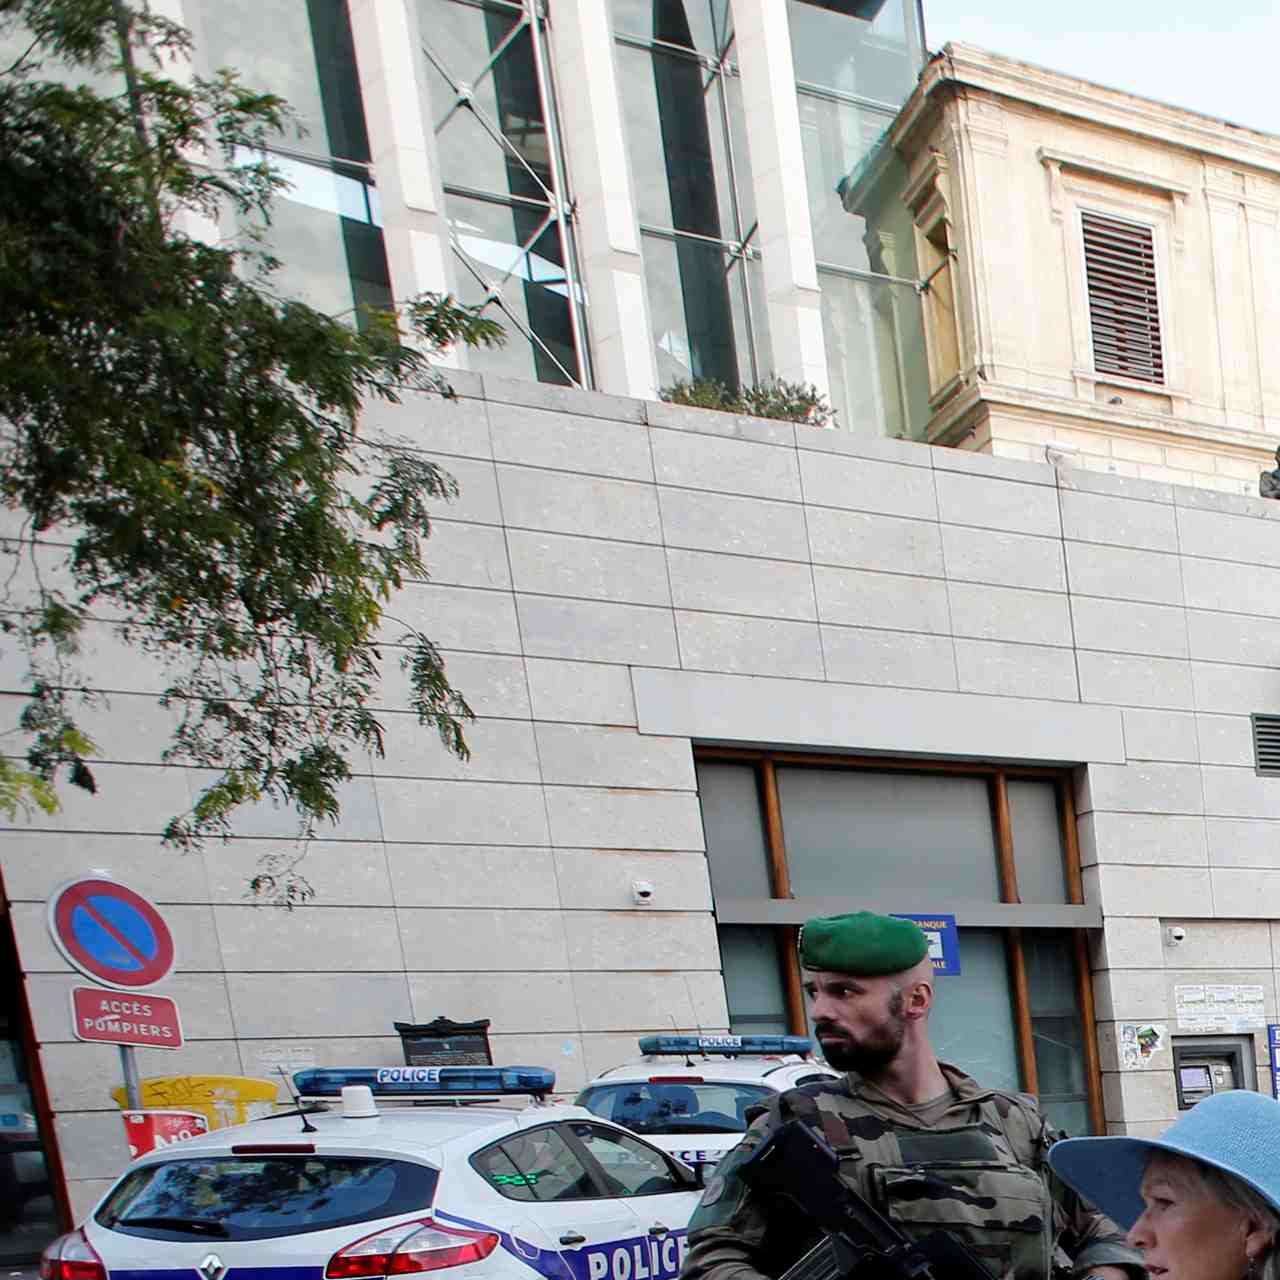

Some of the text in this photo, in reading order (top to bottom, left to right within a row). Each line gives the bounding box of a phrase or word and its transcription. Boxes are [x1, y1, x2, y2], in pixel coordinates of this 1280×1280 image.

[100, 999, 152, 1017] ACCÈS
[83, 1018, 173, 1038] POMPIERS
[700, 1036, 739, 1046] POLICE
[380, 1069, 437, 1081] POLICE
